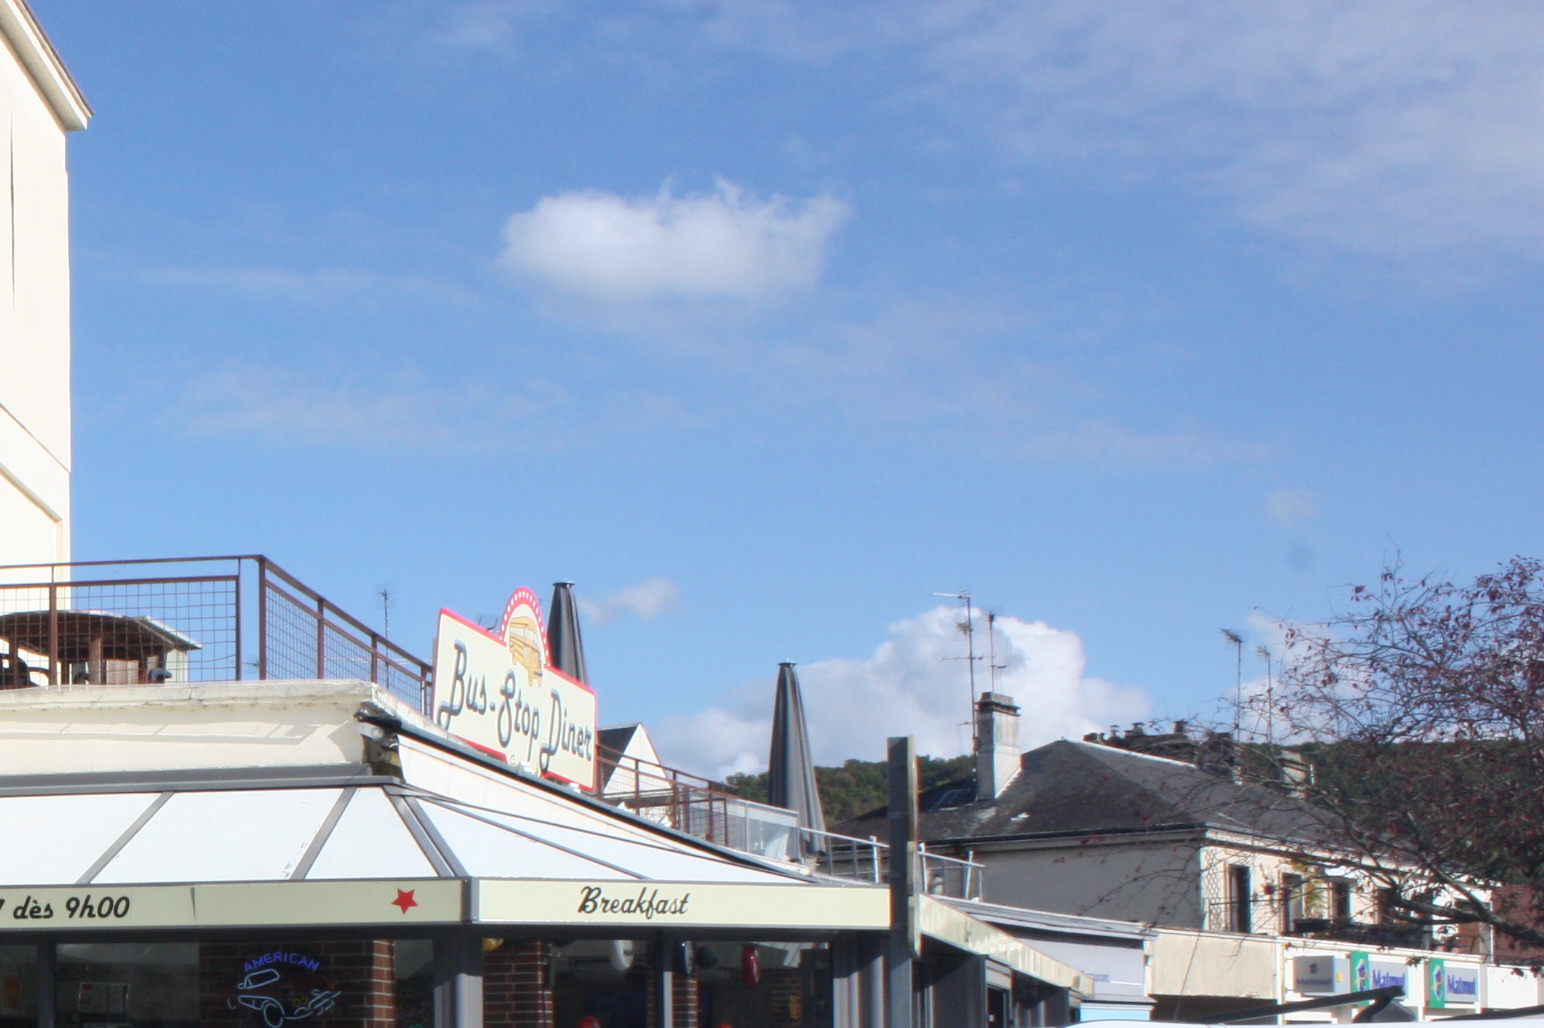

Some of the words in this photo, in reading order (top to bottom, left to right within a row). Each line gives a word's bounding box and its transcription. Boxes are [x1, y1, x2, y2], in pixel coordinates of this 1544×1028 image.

[539, 688, 592, 772] Diner
[12, 895, 55, 920] dès
[65, 894, 131, 919] 9h00
[577, 885, 691, 920] Breakfast
[243, 951, 321, 973] AMERICAN
